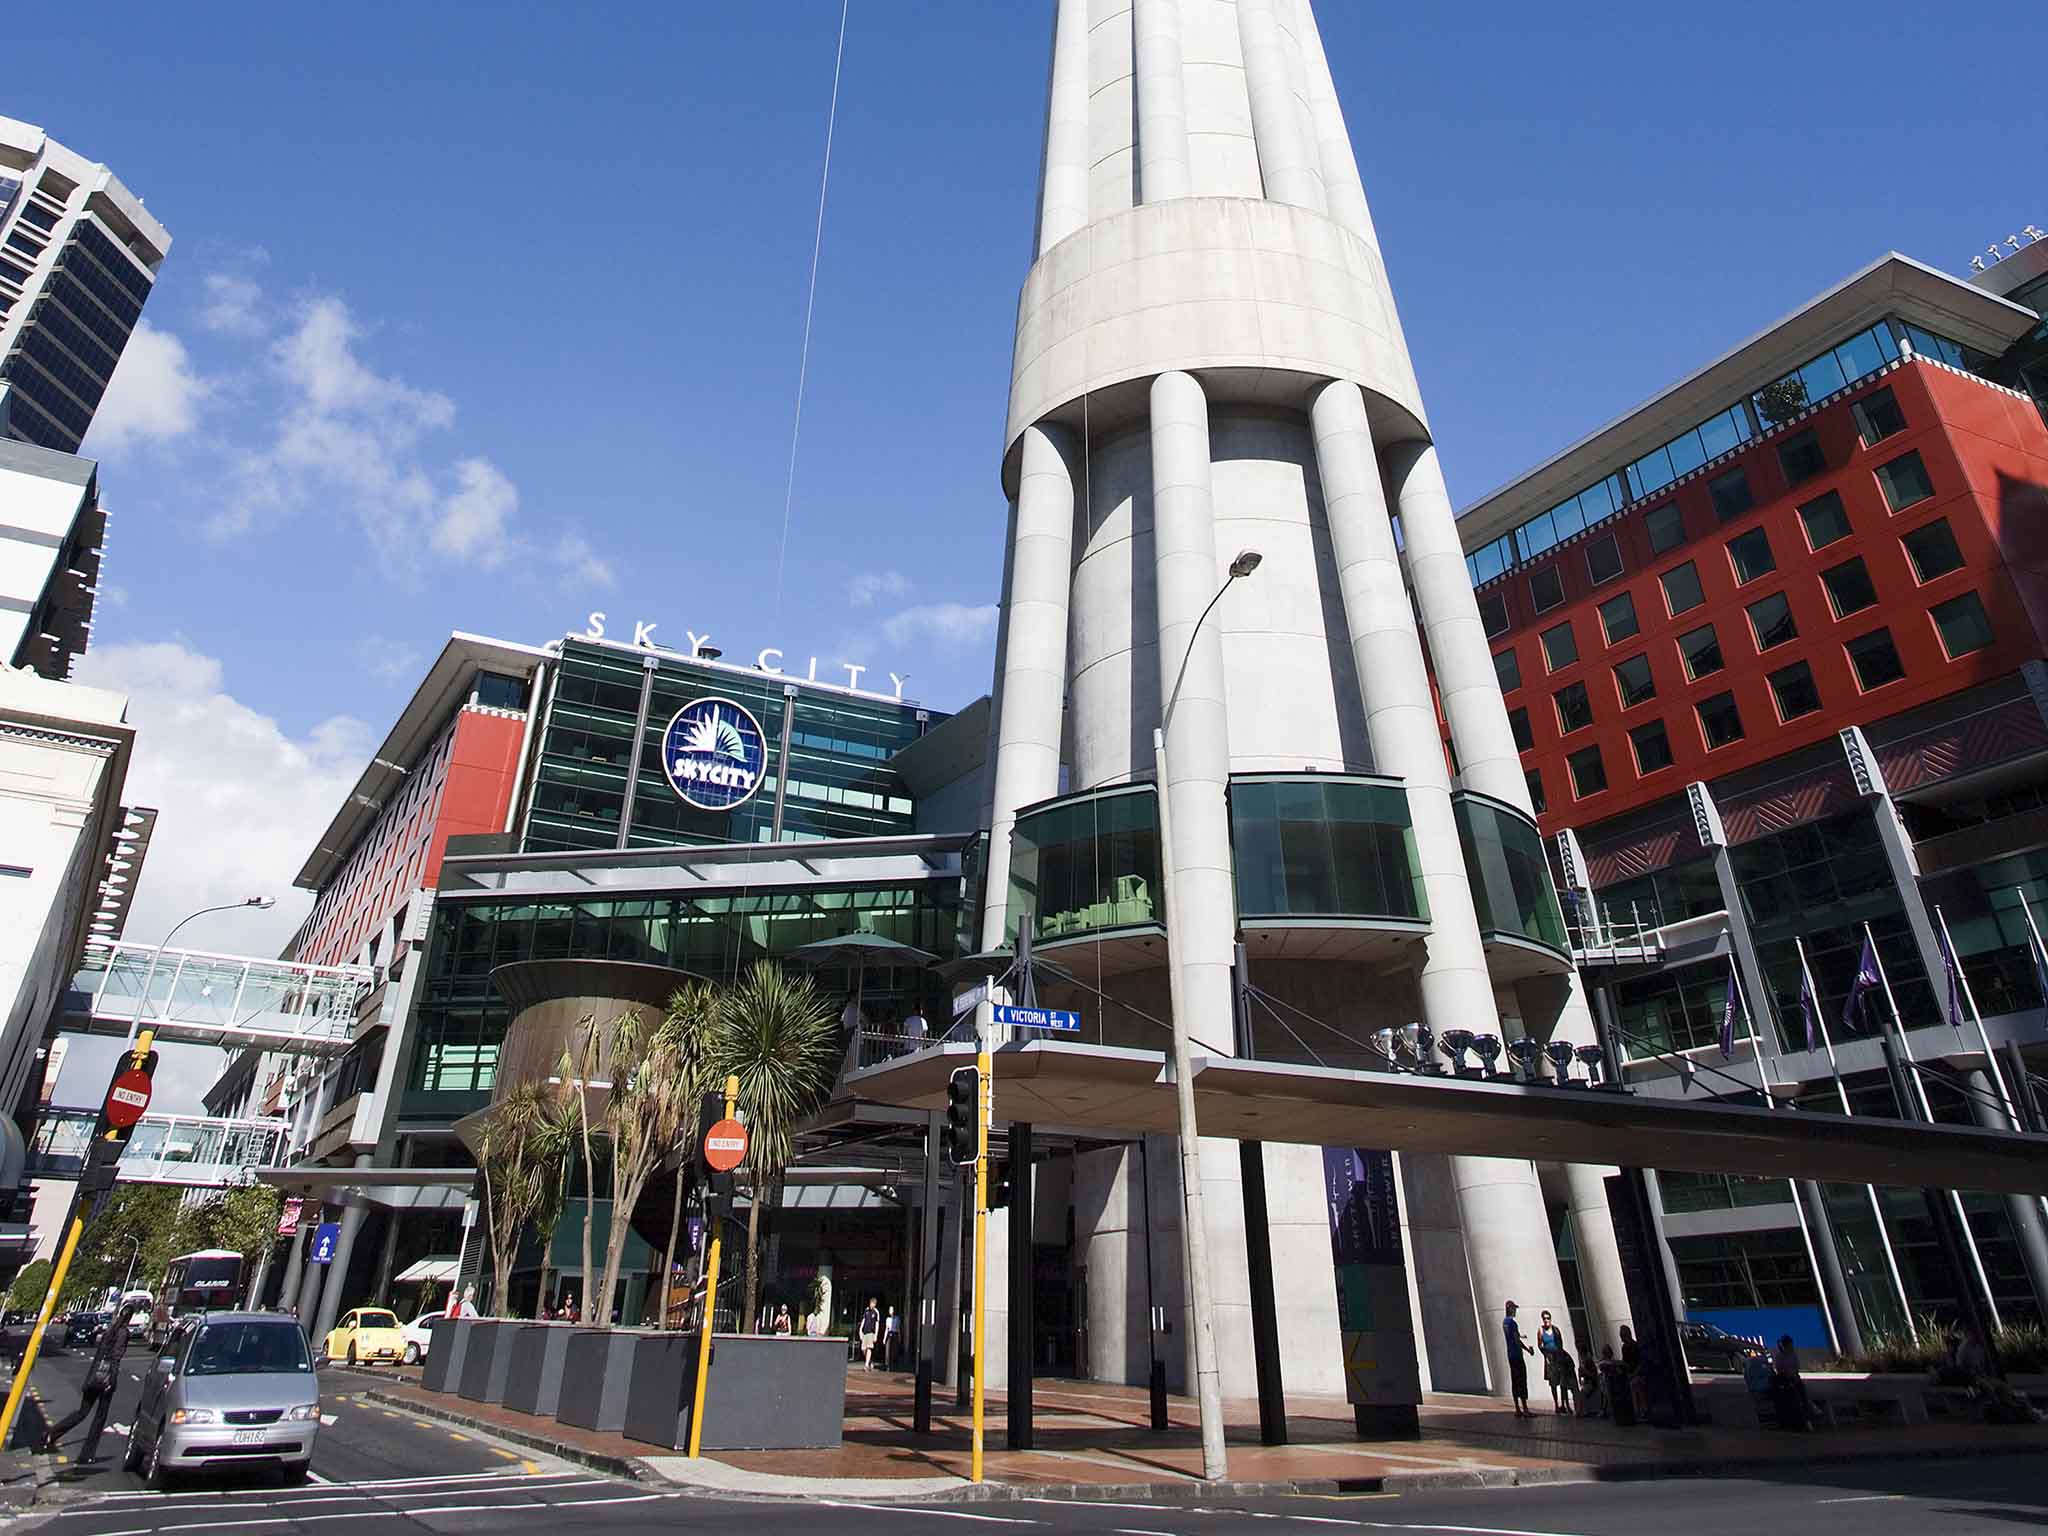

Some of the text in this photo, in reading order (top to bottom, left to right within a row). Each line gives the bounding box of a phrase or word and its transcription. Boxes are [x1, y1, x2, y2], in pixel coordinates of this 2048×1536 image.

[586, 612, 909, 699] SKY CITY
[674, 758, 755, 790] SKYCITY
[1010, 1009, 1057, 1025] VICTORIA ST
[118, 1090, 126, 1100] NO
